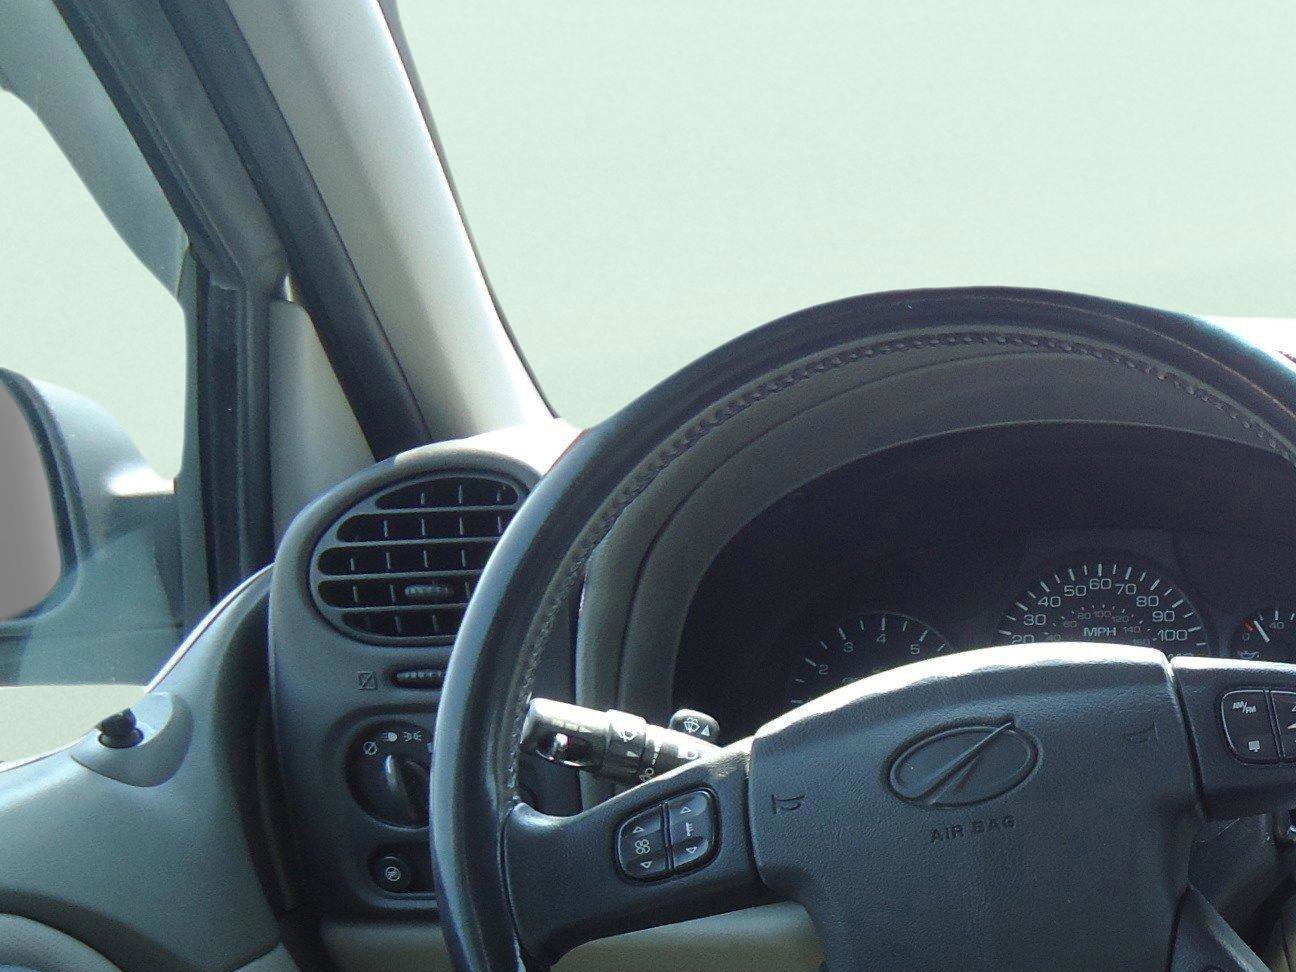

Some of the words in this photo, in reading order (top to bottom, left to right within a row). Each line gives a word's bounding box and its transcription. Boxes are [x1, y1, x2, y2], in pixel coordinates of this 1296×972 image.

[1089, 578, 1112, 590] 60
[1115, 583, 1137, 595] 70
[1064, 585, 1087, 597] 50
[1037, 596, 1062, 607] 40
[1136, 595, 1159, 607] 80
[1023, 613, 1047, 626] 30
[1152, 610, 1175, 622] 90
[1269, 621, 1285, 630] 40
[1083, 627, 1117, 637] MPH
[1158, 629, 1188, 641] 100
[876, 633, 887, 644] 4
[1011, 634, 1035, 644] 20
[843, 642, 854, 653] 3
[910, 644, 920, 655] 5
[818, 664, 829, 675] 2
[931, 824, 965, 843] AIR
[970, 814, 1016, 834] BAG
